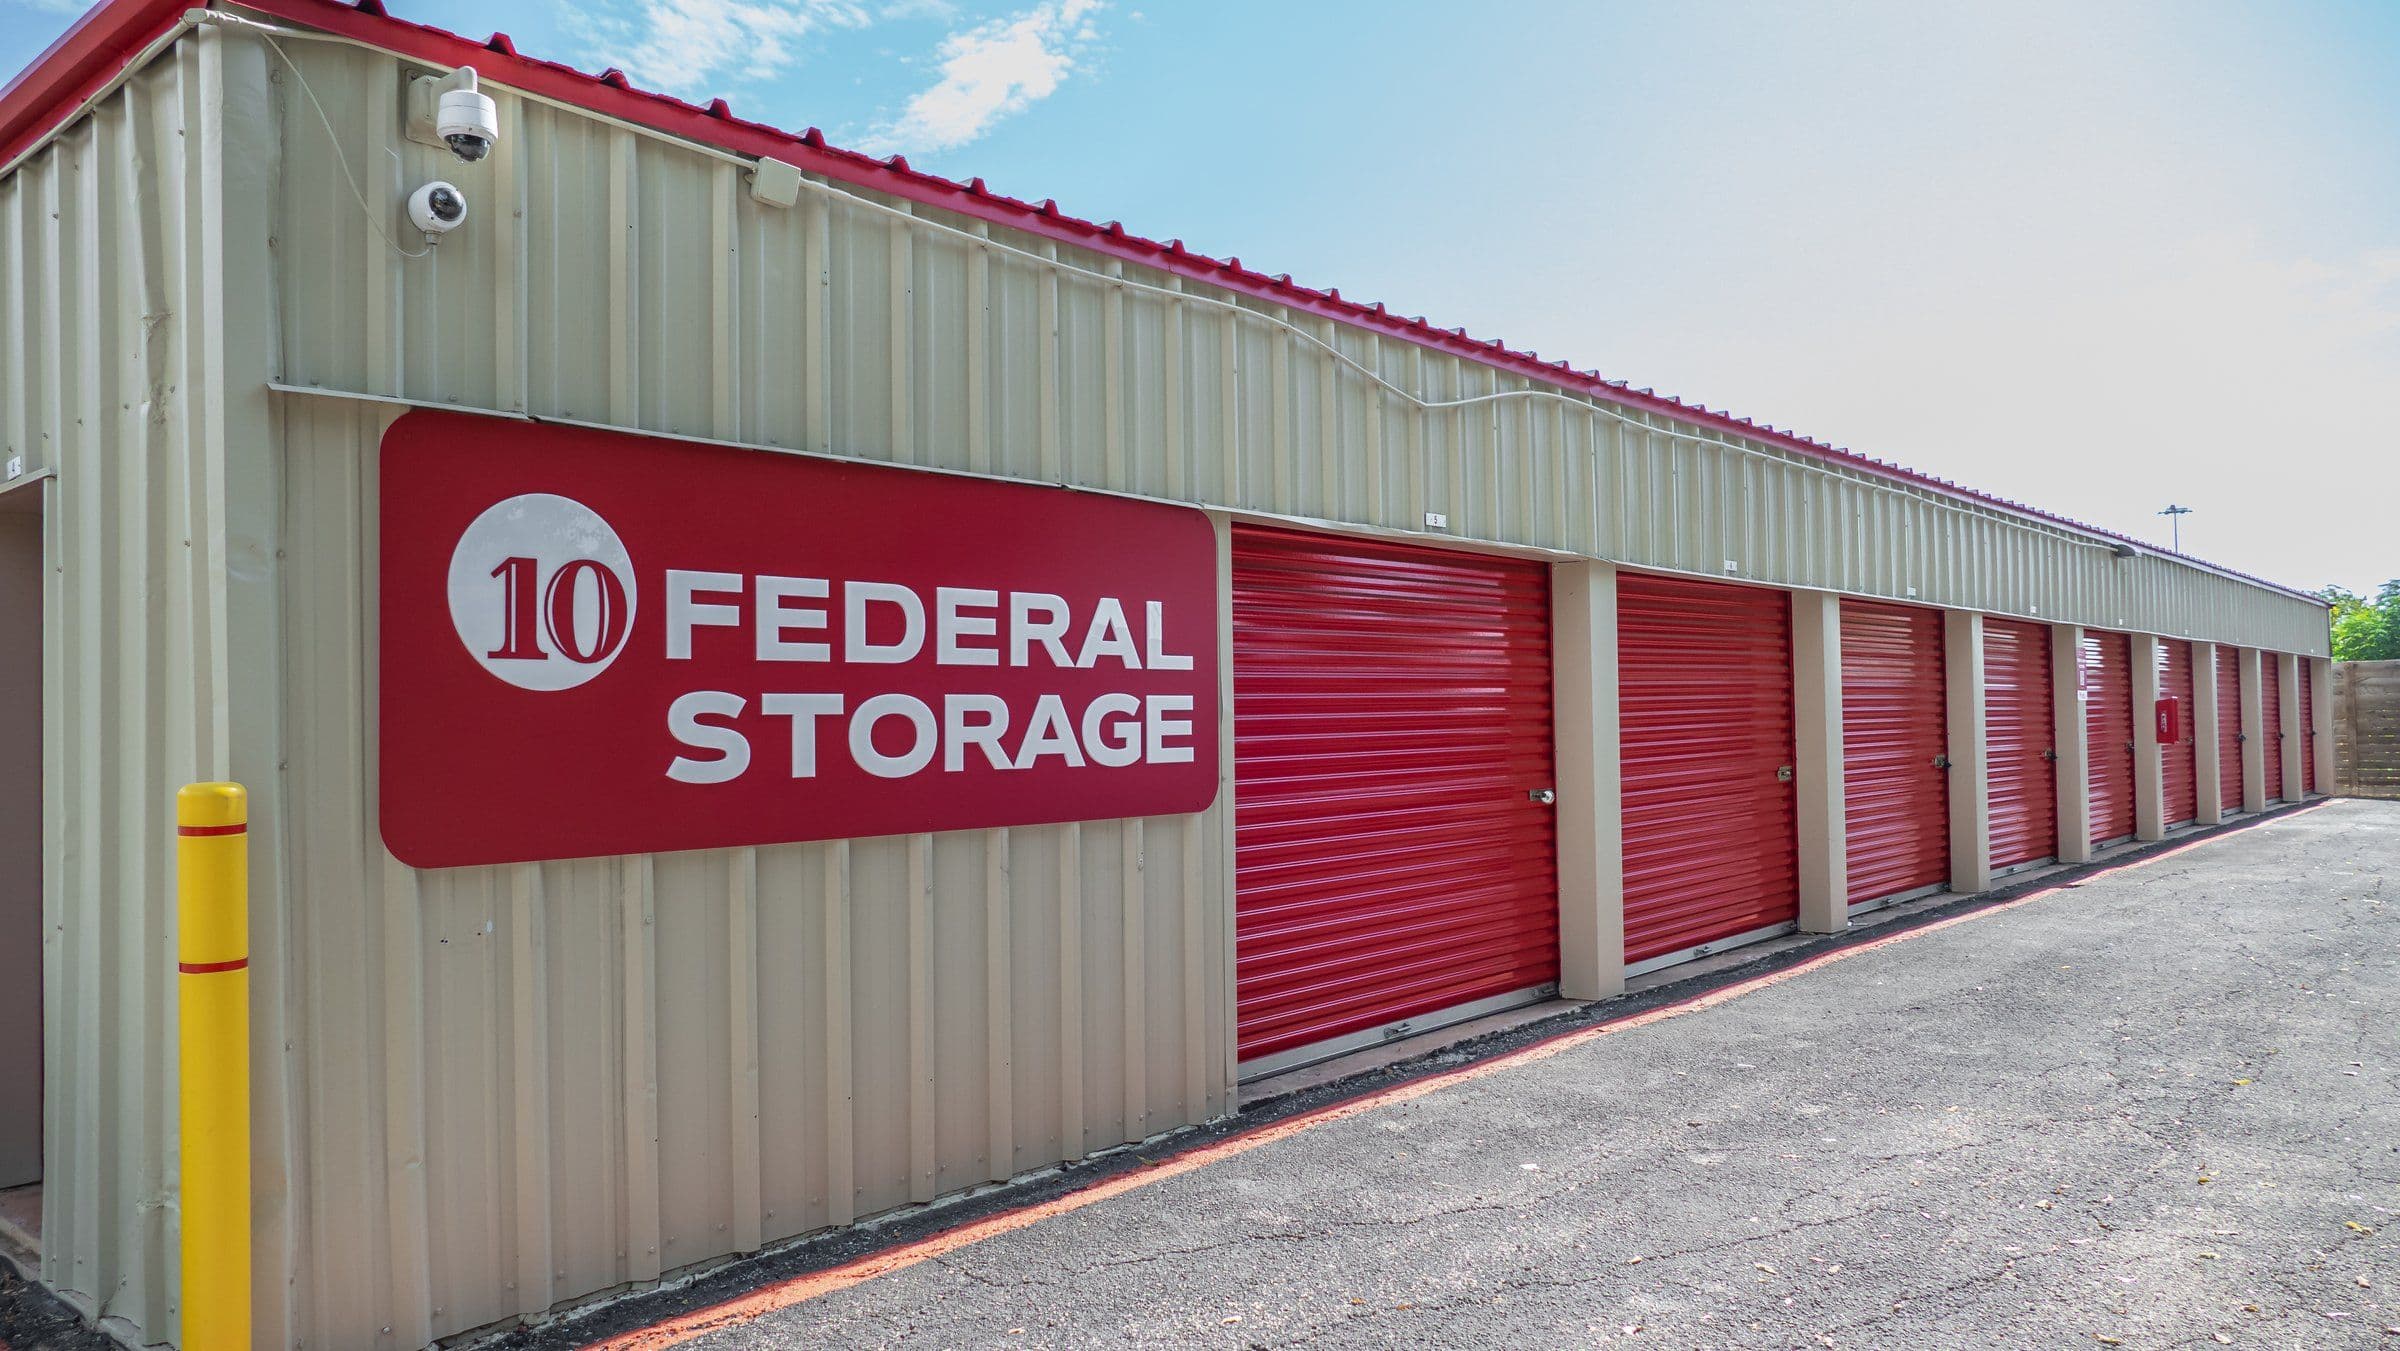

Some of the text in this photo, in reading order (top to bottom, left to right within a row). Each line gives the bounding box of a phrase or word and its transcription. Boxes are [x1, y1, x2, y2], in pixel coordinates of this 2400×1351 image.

[487, 556, 1194, 670] 10 FEDERAL
[665, 690, 1195, 784] STORAGE
